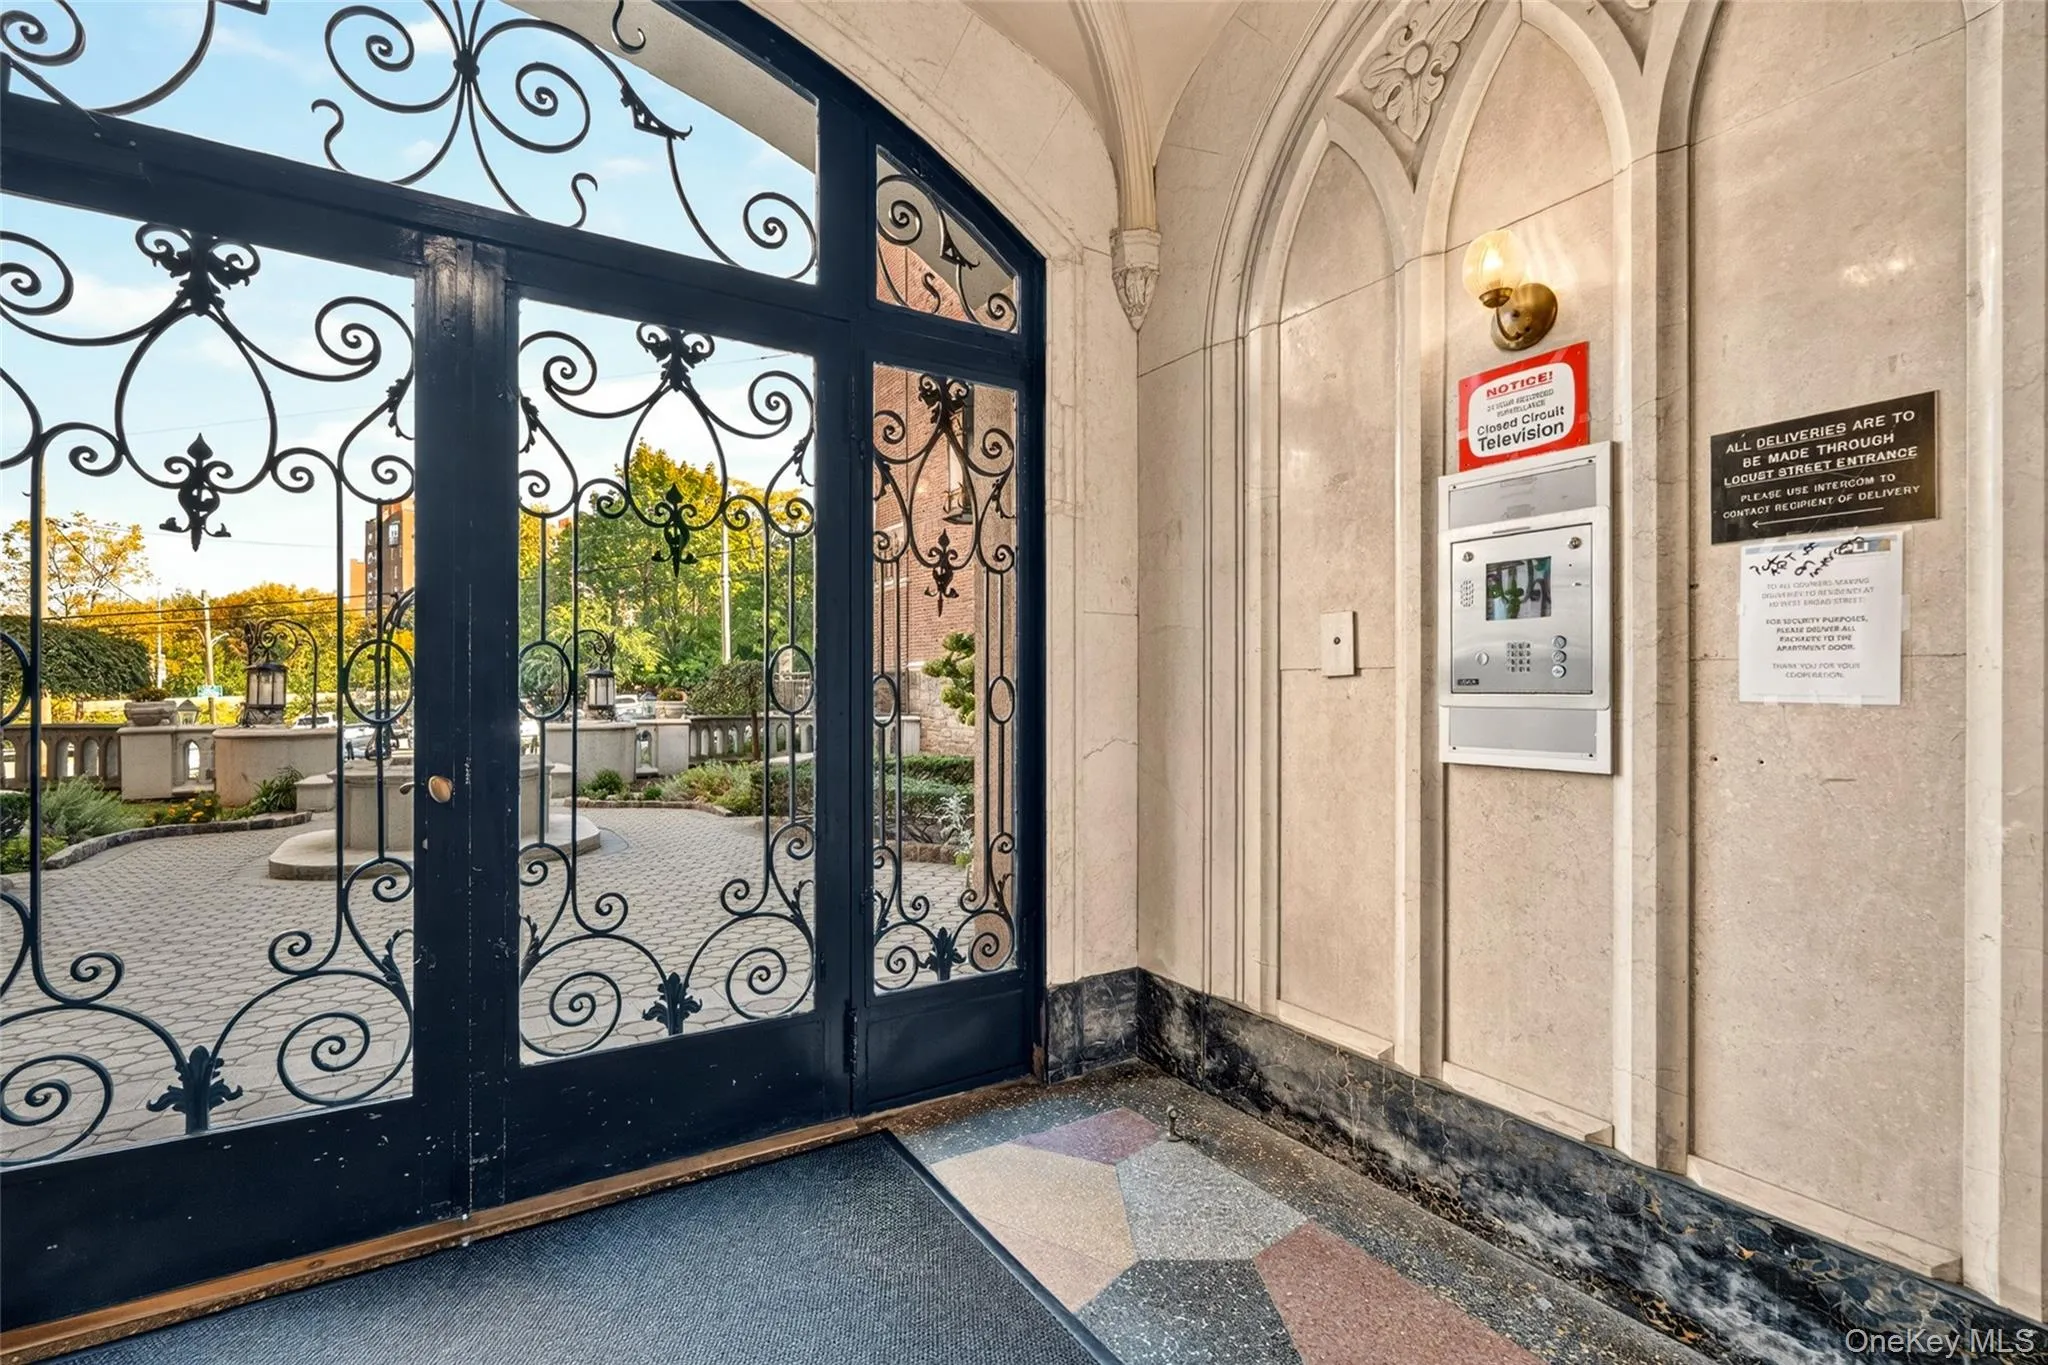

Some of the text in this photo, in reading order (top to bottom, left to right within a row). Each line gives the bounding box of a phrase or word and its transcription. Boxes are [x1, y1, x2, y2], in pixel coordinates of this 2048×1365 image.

[1487, 371, 1553, 397] NOTICE!
[1477, 405, 1565, 436] Closed Circuit
[1477, 421, 1564, 451] Television
[1725, 410, 1915, 454] ALL DELIVERIES ARE TO
[1724, 445, 1918, 487] LOCUST STREET ENTRANCE
[1743, 433, 1894, 468] BE MADE THROUGH
[1722, 485, 1920, 519] CONTACT RECIPIENT OF DELIVERY
[1740, 473, 1896, 502] PLEASE USE INTERCOM TO
